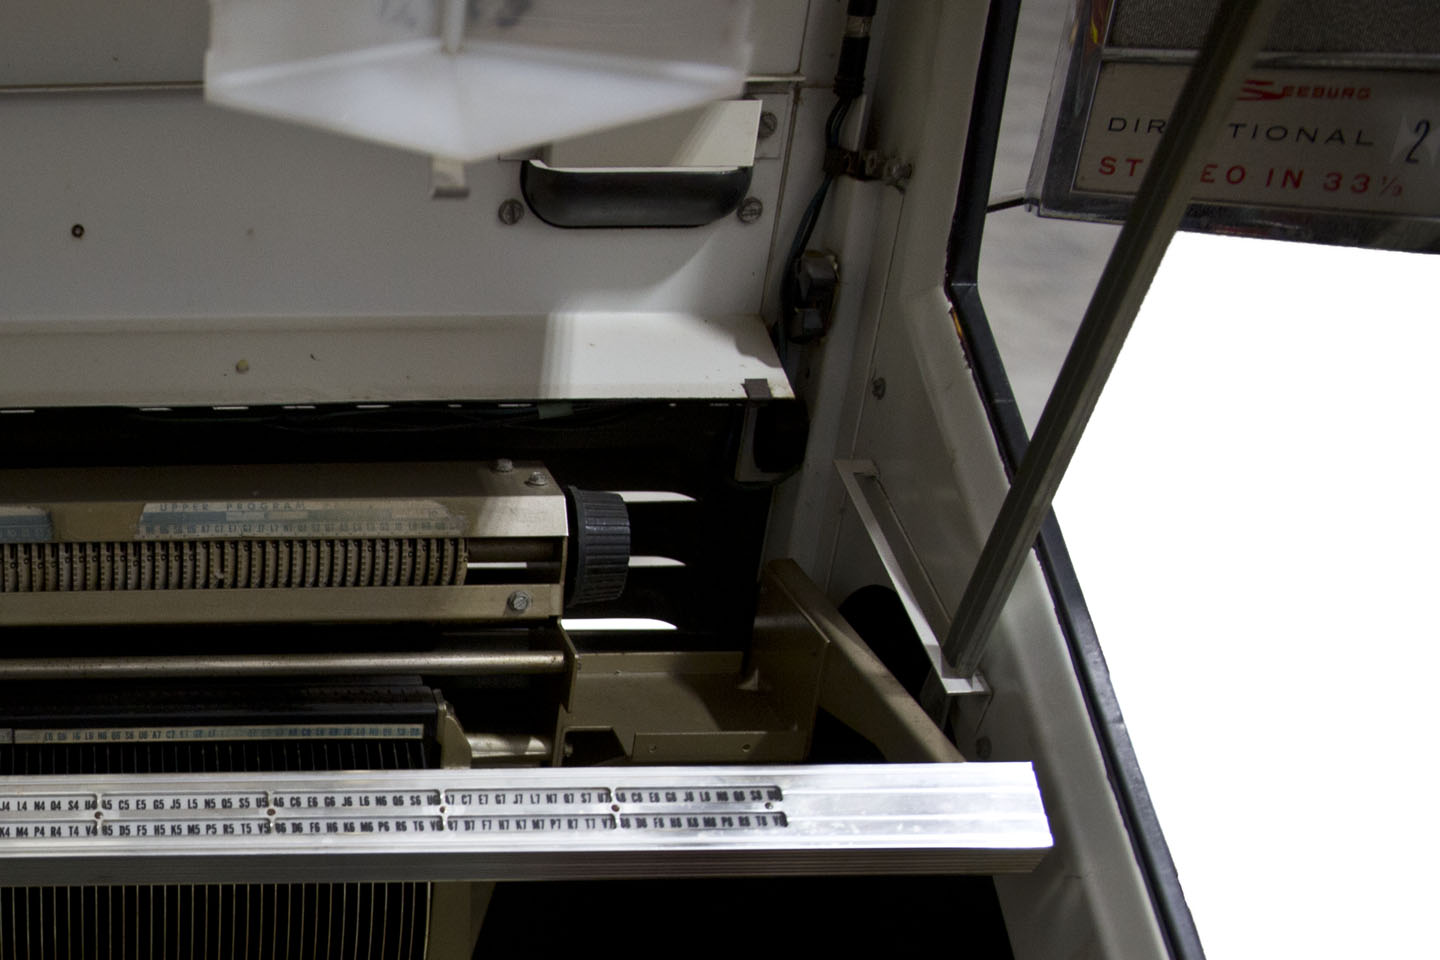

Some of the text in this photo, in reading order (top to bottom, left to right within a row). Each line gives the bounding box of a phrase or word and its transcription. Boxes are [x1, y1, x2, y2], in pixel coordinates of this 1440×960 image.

[1108, 117, 1431, 164] DIRTIONAL 2
[1098, 156, 1246, 185] STEO
[1266, 167, 1303, 189] IN
[0, 801, 10, 811] J4
[17, 801, 27, 811] L4
[34, 801, 45, 811] N4
[68, 801, 79, 810] S4
[118, 799, 129, 809] C5
[136, 799, 146, 809] E5
[170, 799, 181, 809] J5
[188, 798, 197, 808] L5
[205, 798, 216, 808] N5
[239, 798, 250, 808] S5
[461, 794, 472, 805] C7
[478, 794, 488, 804] E7
[0, 827, 10, 837] K4
[16, 826, 28, 837] M4
[34, 826, 45, 837] P4
[51, 826, 61, 836] R4
[69, 826, 79, 836] T4
[119, 825, 130, 836] D5
[137, 825, 147, 835] F5
[154, 825, 165, 835] H5
[171, 824, 182, 835] K5
[188, 824, 200, 835] M5
[206, 824, 217, 834] P5
[223, 823, 234, 834] R5
[241, 823, 251, 834] T5
